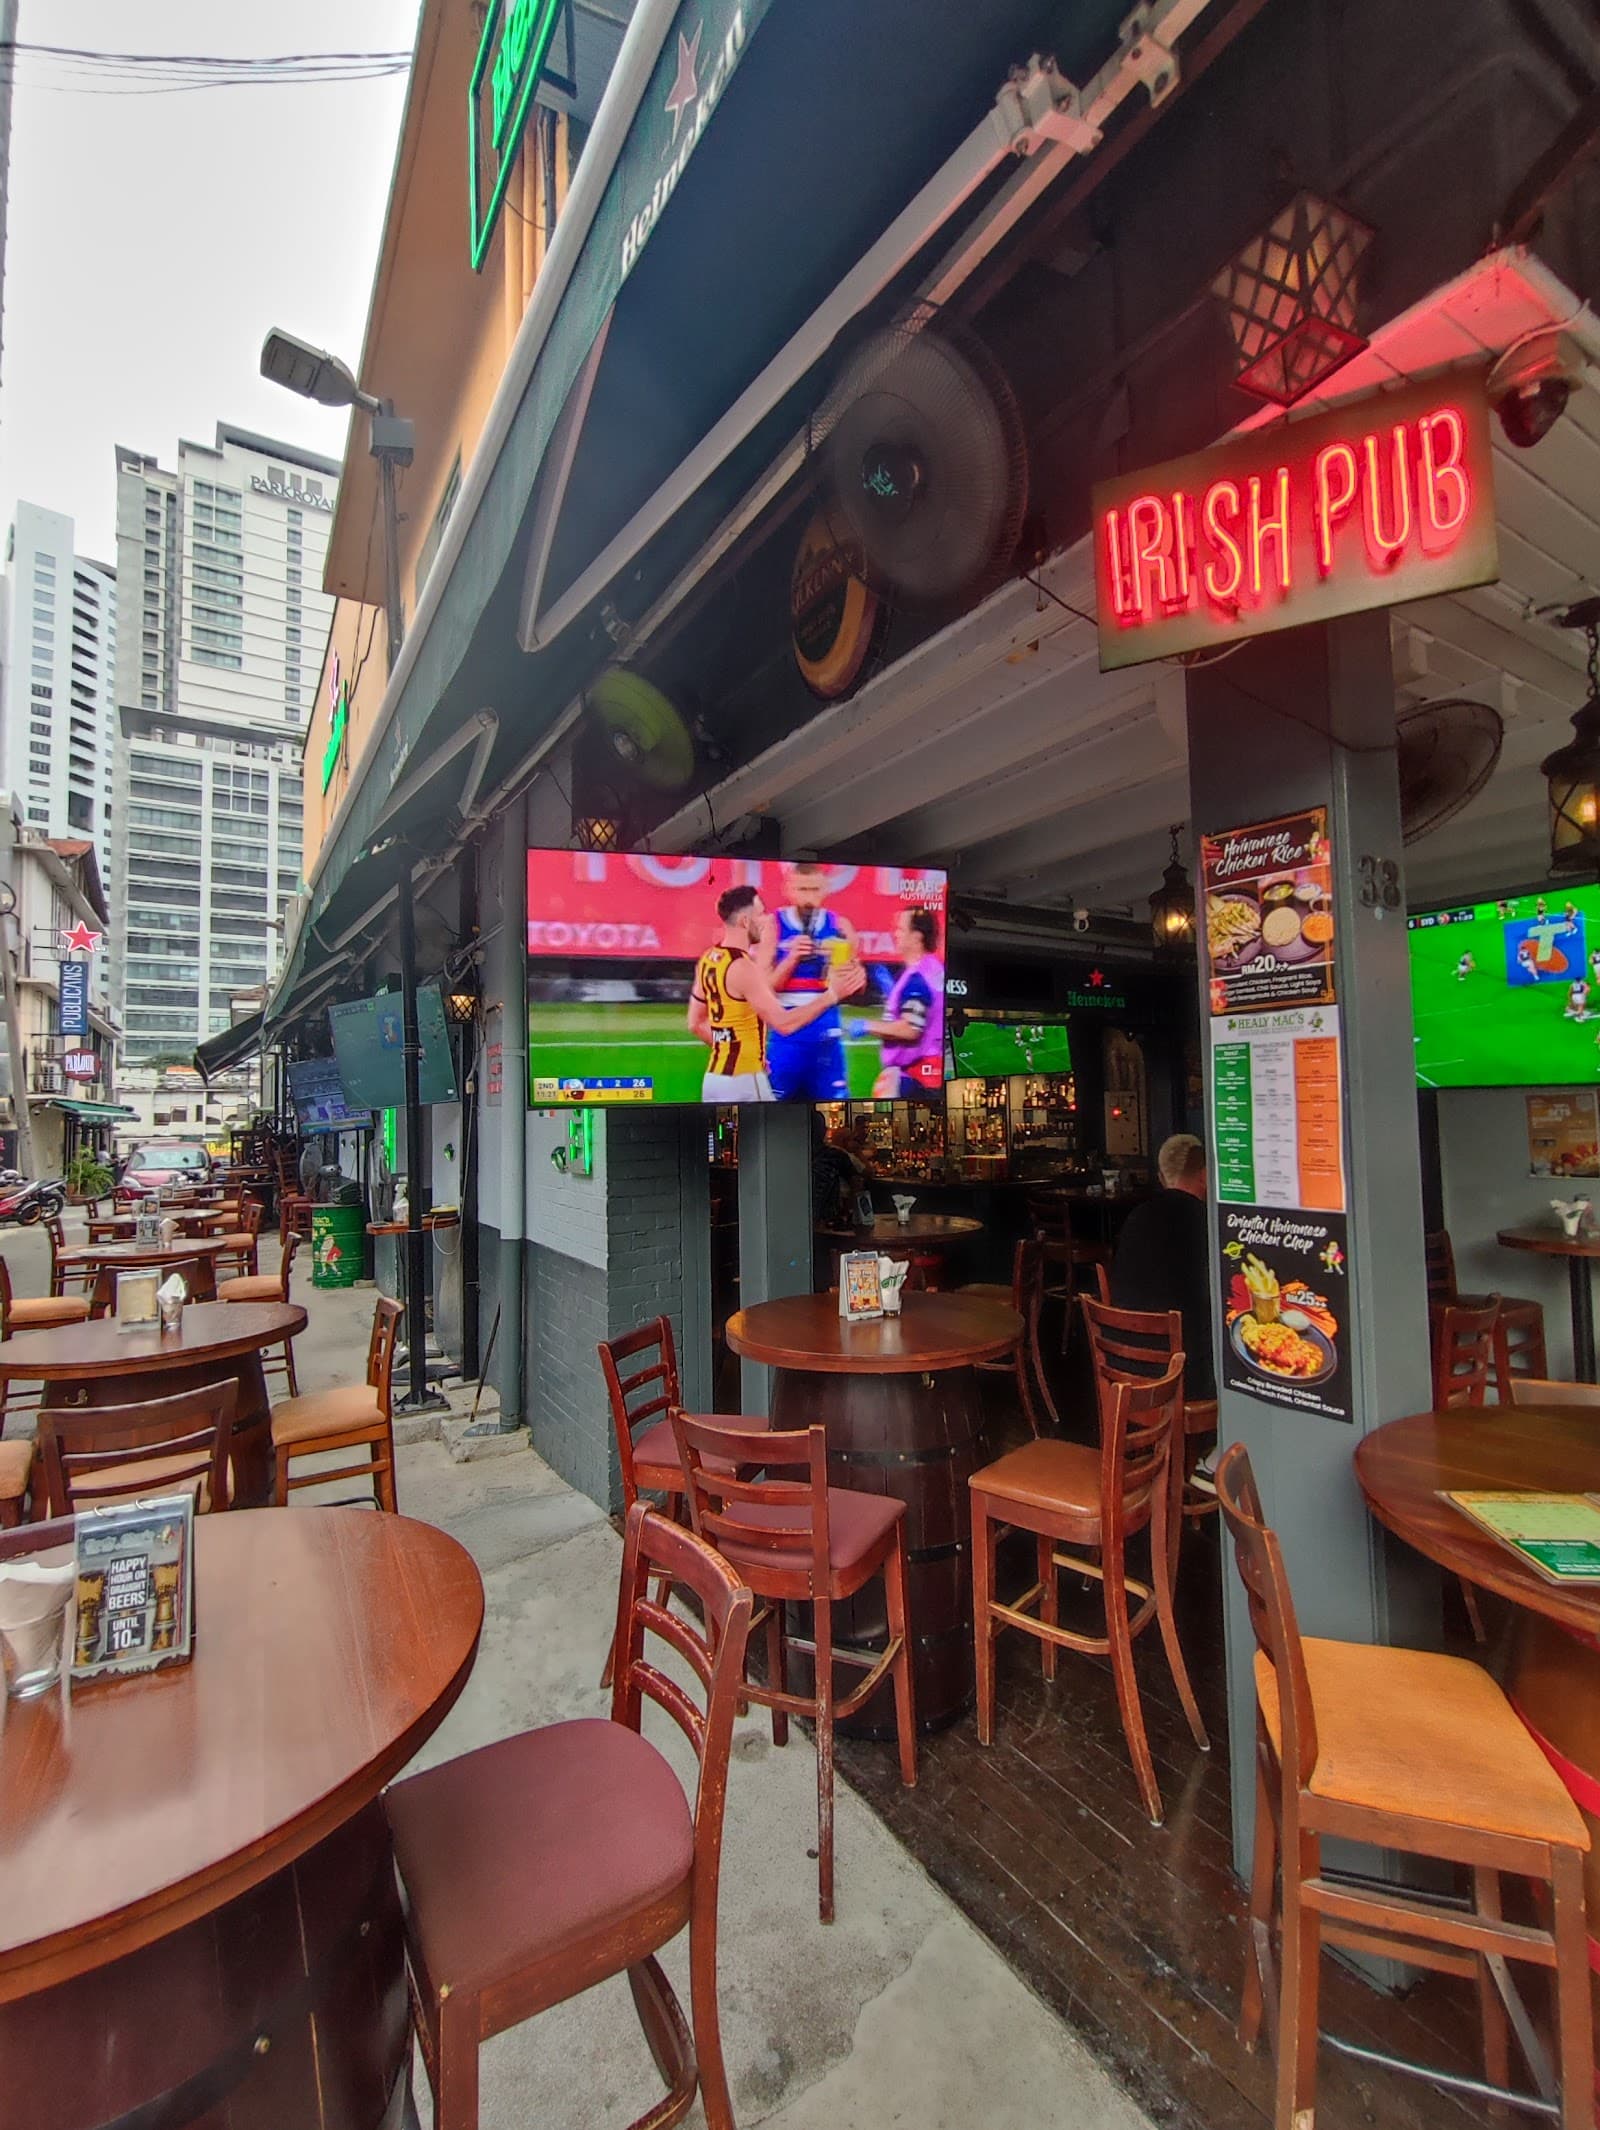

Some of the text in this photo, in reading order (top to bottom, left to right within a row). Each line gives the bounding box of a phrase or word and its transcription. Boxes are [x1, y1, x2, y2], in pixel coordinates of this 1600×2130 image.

[1106, 408, 1471, 617] IRISH PUB
[1224, 832, 1290, 859] Hainanese
[1216, 845, 1302, 876] Chicken Rice
[924, 902, 944, 910] LIVE
[528, 921, 661, 949] TOYOTA
[62, 964, 83, 1029] PUBLICANS
[1067, 991, 1126, 1008] Heineken
[1238, 1012, 1305, 1030] HEALY MAC'S
[633, 1079, 645, 1088] 26
[1227, 1213, 1327, 1237] Oriental Hainanese
[1238, 1229, 1313, 1254] Chicken Chop
[1293, 1388, 1321, 1401] Chicken
[1322, 1404, 1345, 1416] Sauce
[111, 1556, 147, 1574] HAPPY
[110, 1569, 146, 1585] HOUR ON
[110, 1581, 146, 1595] DRAUGHT
[109, 1591, 146, 1610] BEERS
[112, 1618, 140, 1631] UNTIL
